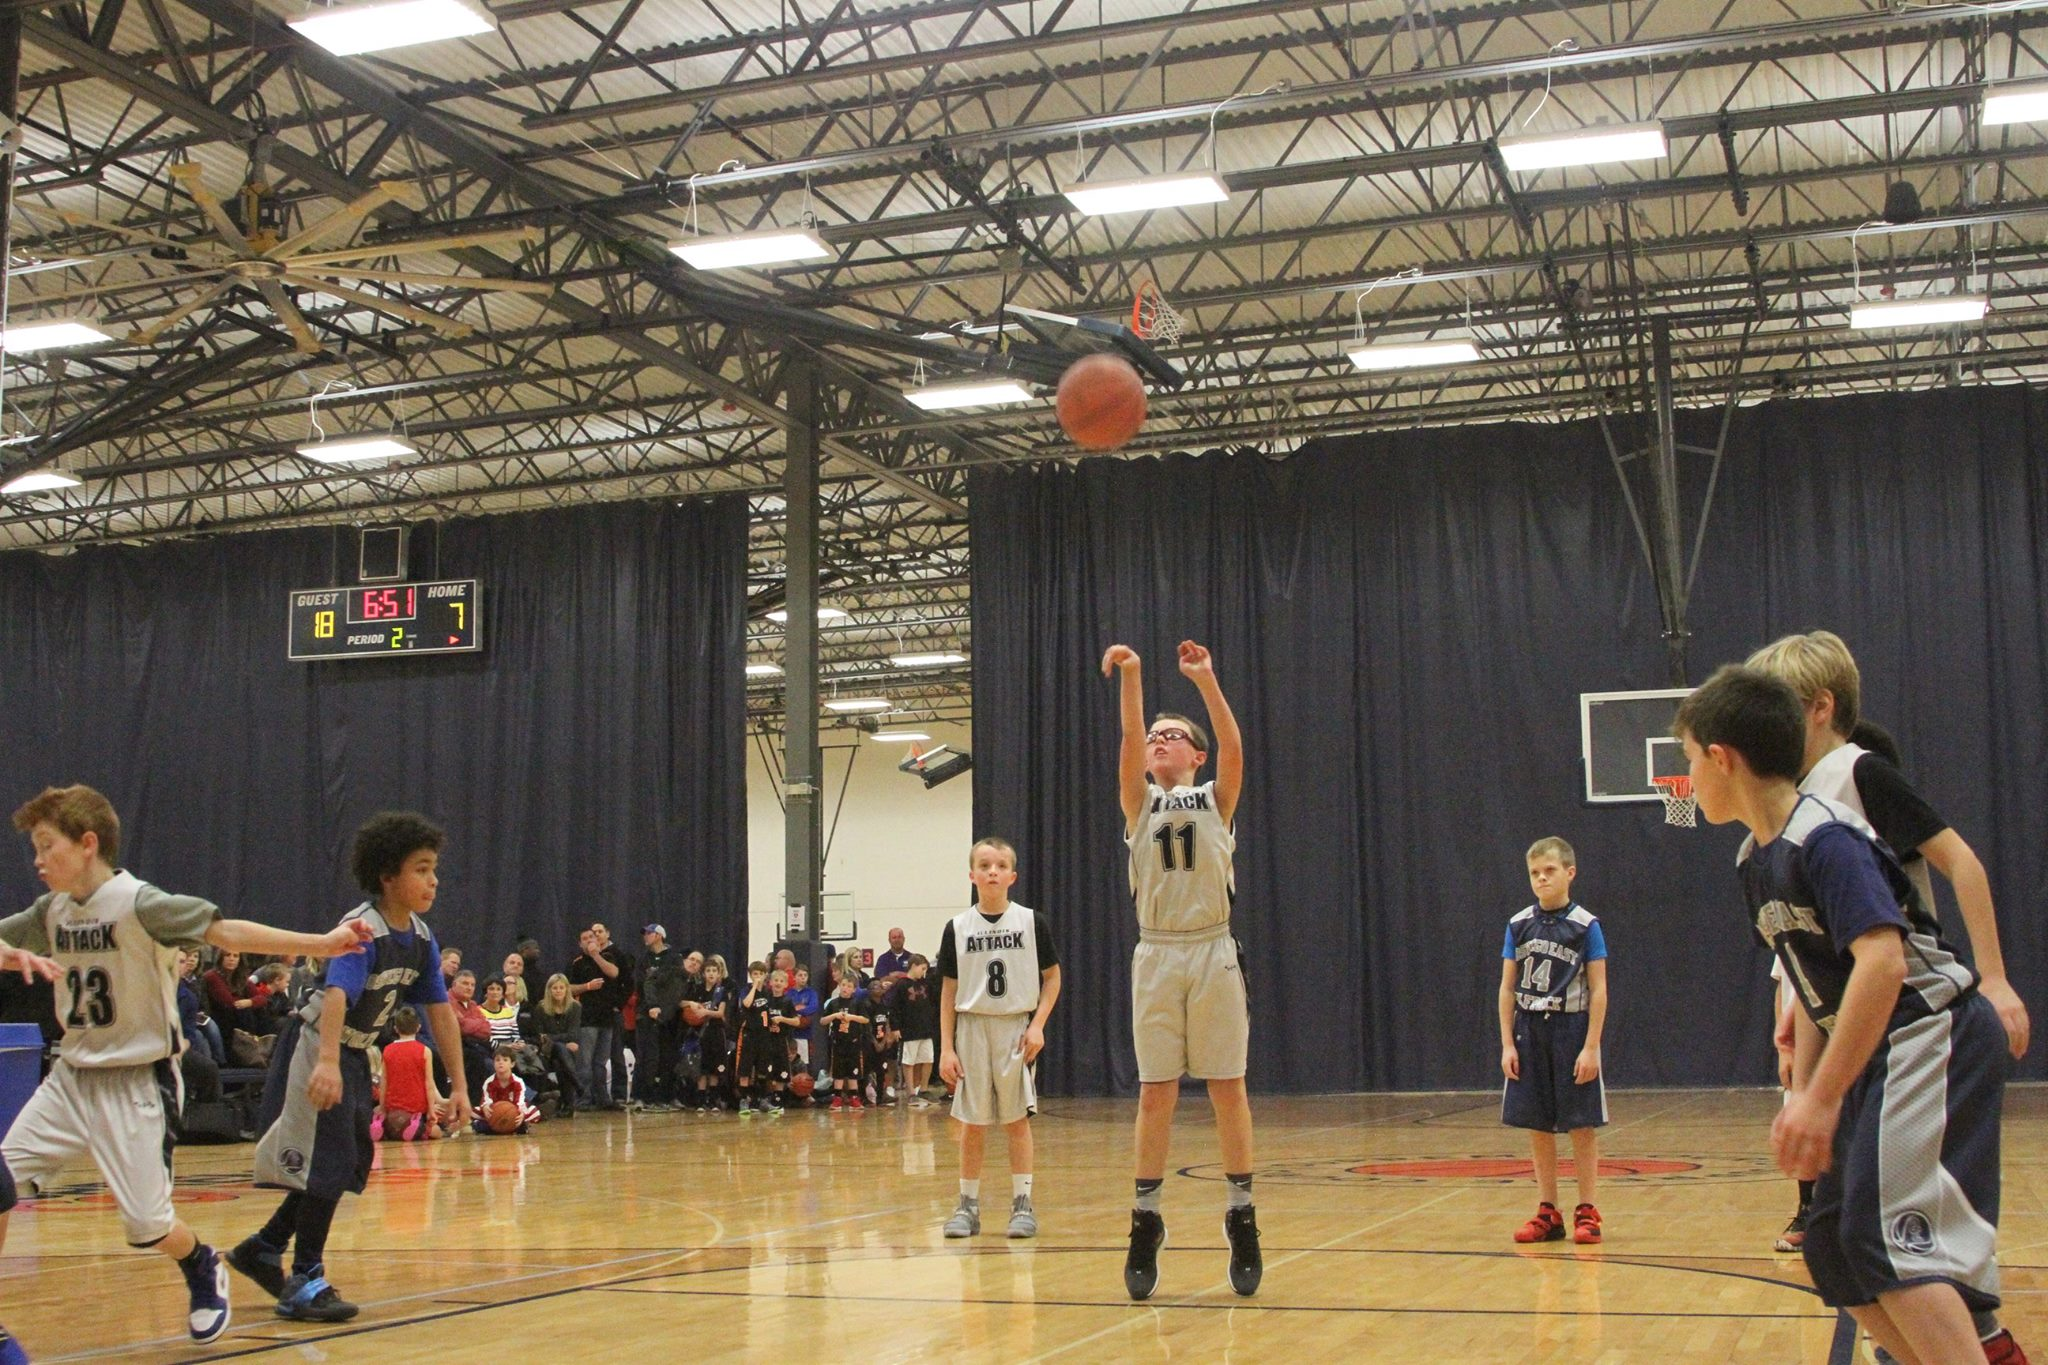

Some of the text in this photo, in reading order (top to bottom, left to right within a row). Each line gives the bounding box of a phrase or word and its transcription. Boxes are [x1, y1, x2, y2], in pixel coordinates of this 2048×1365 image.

[297, 593, 339, 607] GUEST
[427, 584, 467, 598] HOME
[314, 611, 335, 639] 18
[449, 602, 464, 630] 7
[347, 627, 404, 649] PERIOD 2
[1152, 821, 1197, 873] 11
[55, 921, 120, 953] ATTACK
[965, 930, 1025, 953] ATTACK
[986, 958, 1008, 999] 8
[1520, 956, 1552, 993] 14
[65, 964, 118, 1029] 23
[372, 988, 398, 1027] 2
